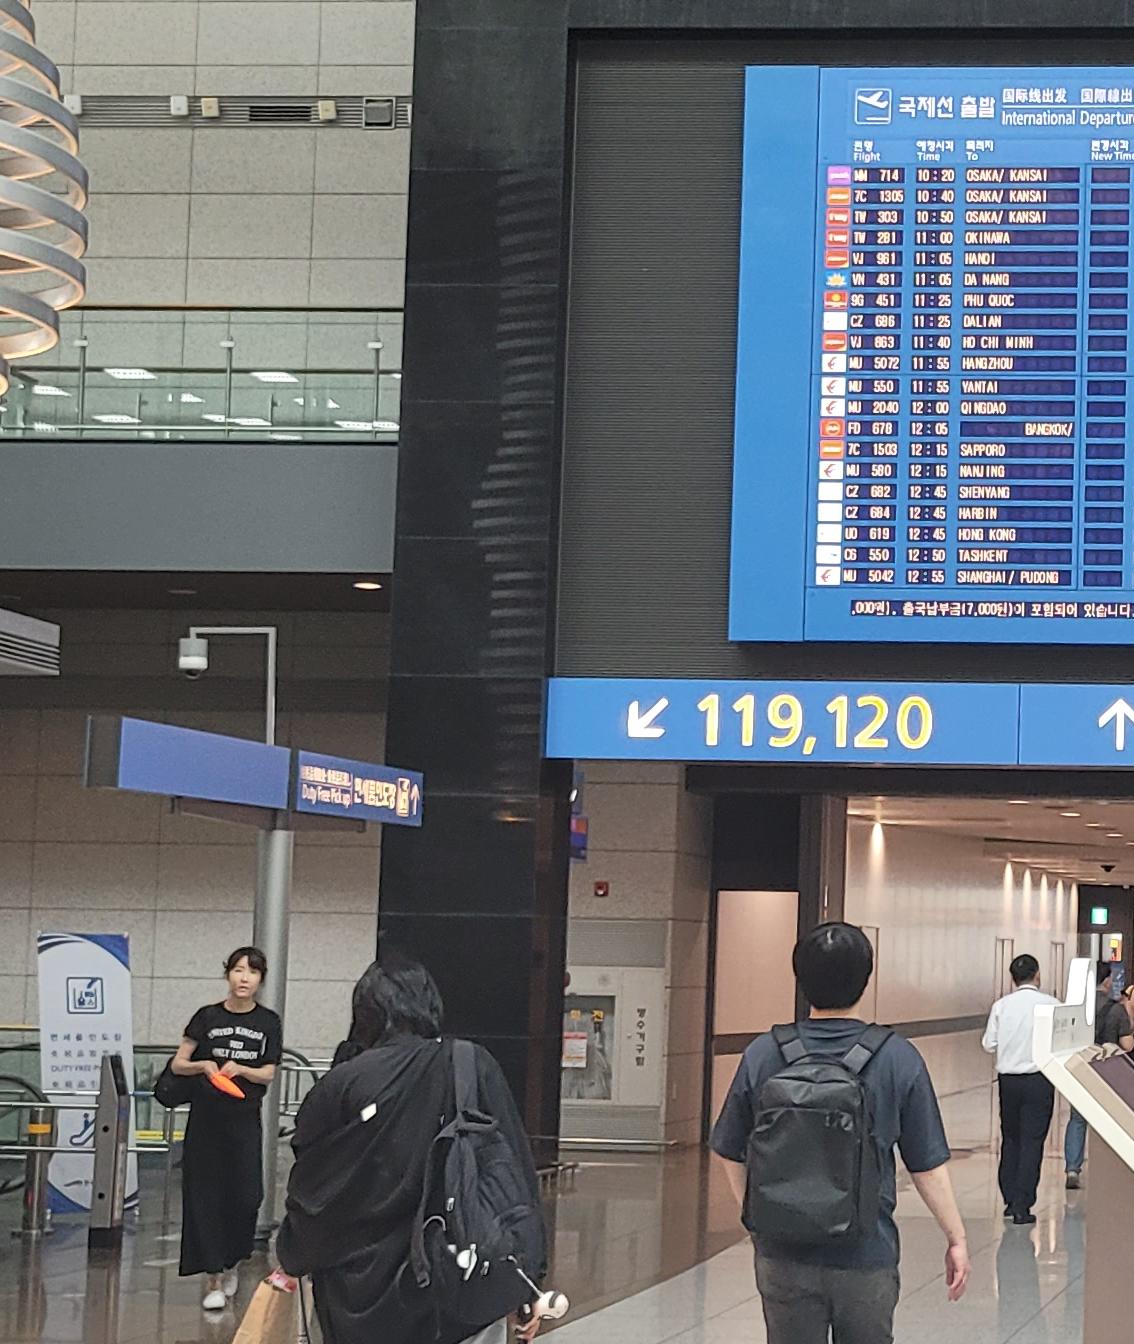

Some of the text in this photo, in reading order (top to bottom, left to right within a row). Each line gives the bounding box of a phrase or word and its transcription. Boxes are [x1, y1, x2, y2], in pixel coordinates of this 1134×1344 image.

[899, 95, 996, 118] 국제선 출발
[1001, 109, 1076, 126] International
[853, 152, 881, 163] Flight
[917, 152, 941, 161] Time
[966, 152, 979, 161] To
[1091, 151, 1113, 161] New
[879, 168, 899, 182] 714
[966, 168, 1005, 183] OSAKA/
[1009, 168, 1048, 182] KANSAI
[854, 189, 867, 203] 7C
[879, 189, 904, 203] 1305
[965, 189, 1004, 204] OSAKA/
[1009, 189, 1047, 203] KANSAI
[965, 210, 1004, 225] OSAKA/
[1008, 210, 1047, 224] KANSAI
[964, 231, 1011, 245] OKINAWA
[964, 252, 995, 265] HANOI
[964, 273, 978, 286] DA
[981, 273, 1010, 286] NANG
[963, 293, 984, 307] PHU
[987, 294, 1015, 307] QUOC
[963, 314, 1002, 328] DALIAN
[962, 335, 1034, 349] HO CHI MINH
[962, 356, 1014, 370] HANGZHOU
[961, 380, 998, 394] YANTAI
[960, 401, 1007, 415] QINGDAO
[960, 443, 1006, 457] SAPPORO
[959, 464, 1006, 478] NANJING
[959, 485, 1010, 499] SHENYANG
[958, 506, 998, 520] HARBIN
[958, 528, 1017, 542] HONG KONG
[958, 549, 1009, 563] TASHKENT
[868, 569, 894, 583] 5042
[957, 570, 1015, 585] SHANGHAI/
[1020, 570, 1059, 584] PUDONG
[1030, 602, 1078, 618] 포함되어
[697, 693, 933, 755] 119,120
